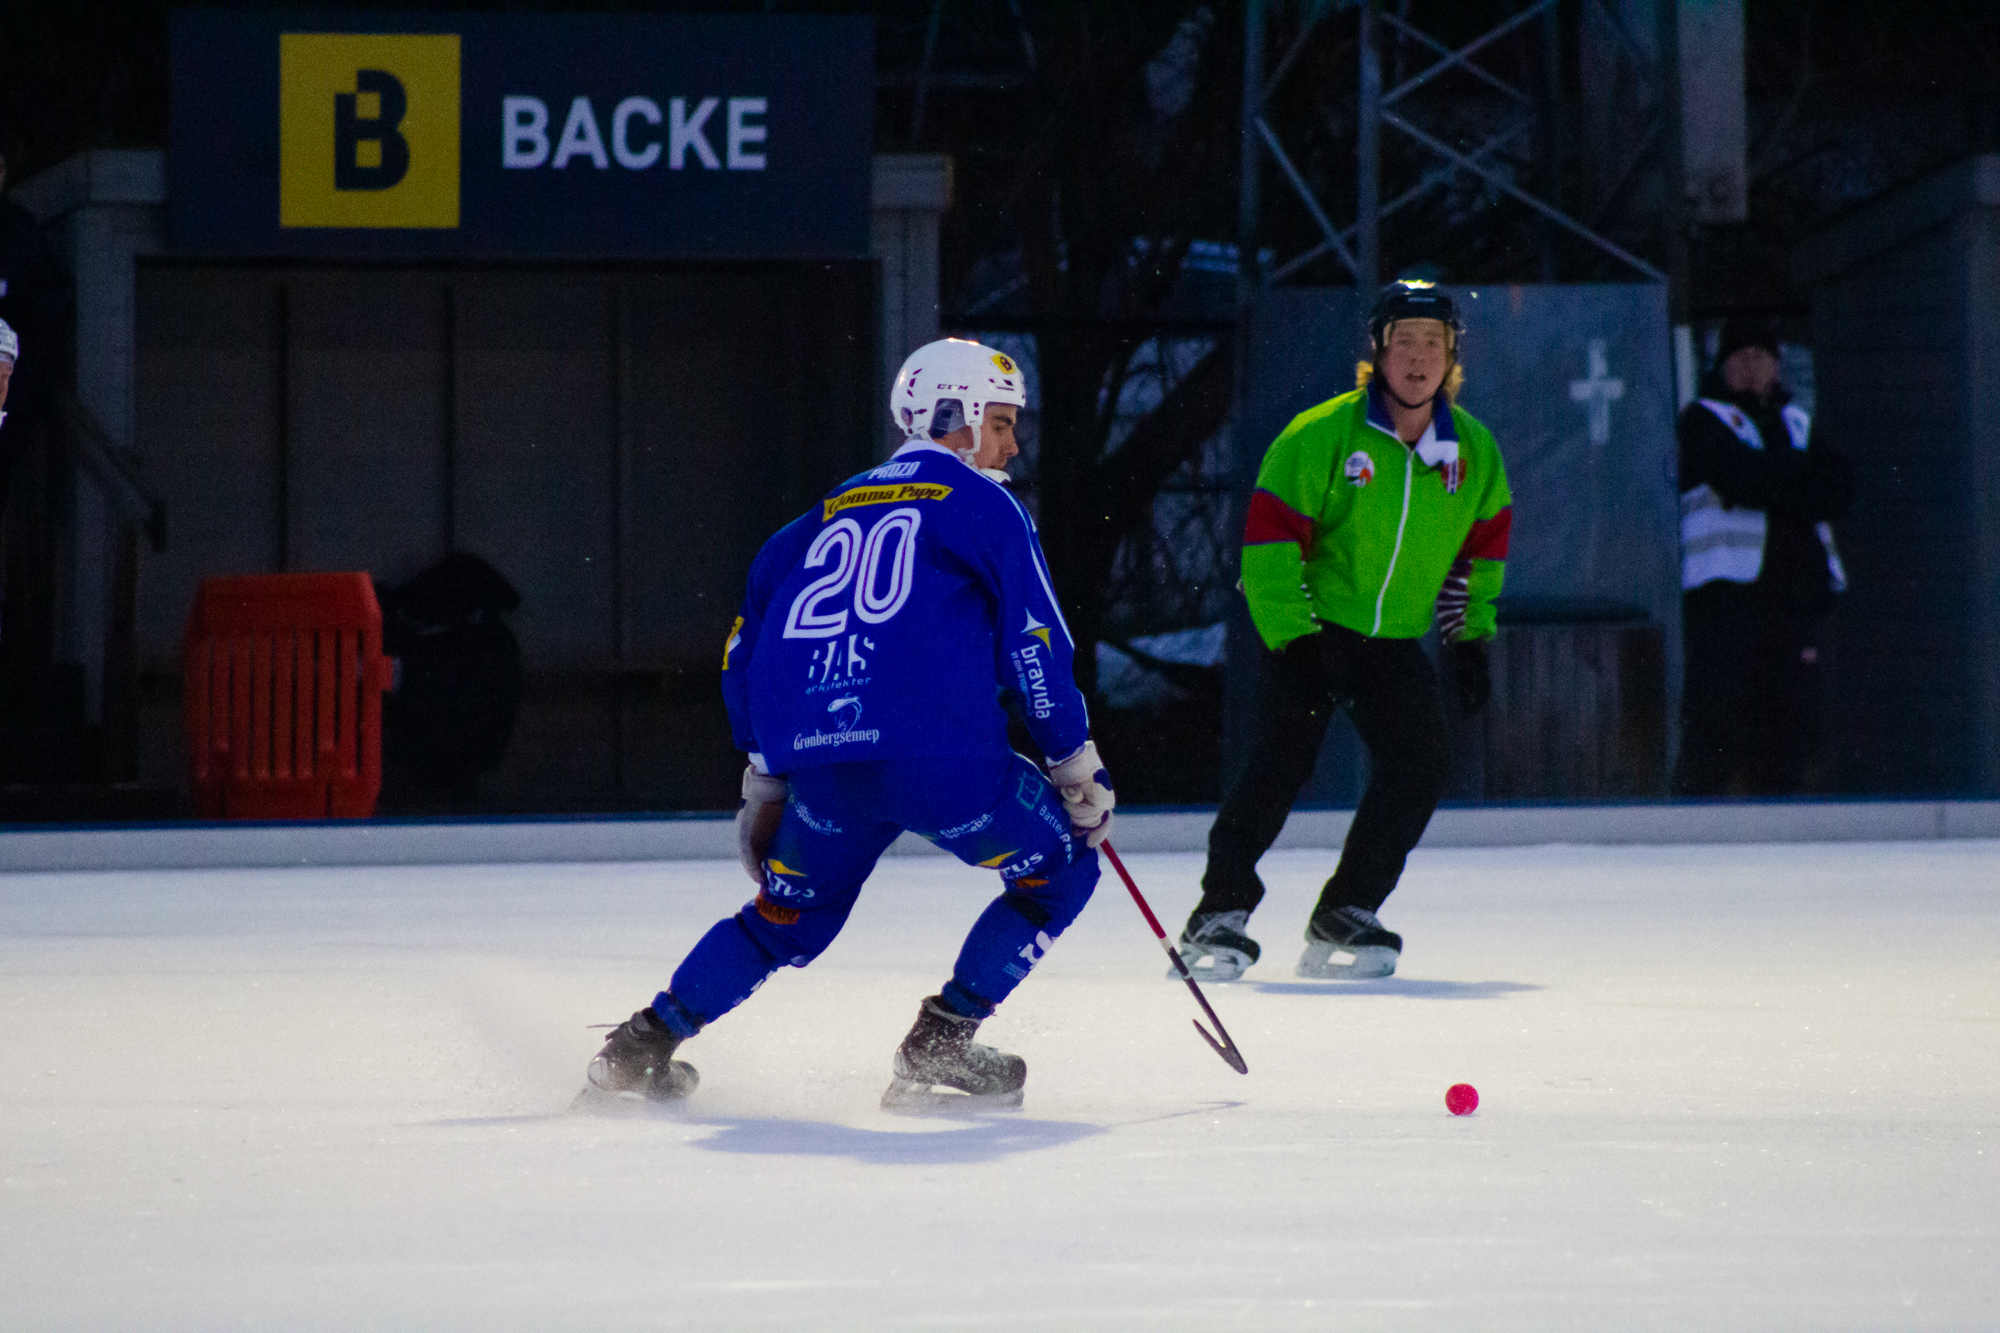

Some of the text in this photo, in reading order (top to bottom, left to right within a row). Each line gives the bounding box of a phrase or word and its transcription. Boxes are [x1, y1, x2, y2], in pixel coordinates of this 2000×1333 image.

[334, 68, 411, 191] B
[502, 94, 768, 171] BACKE
[936, 383, 969, 392] CCM
[828, 485, 943, 515] Glomma Papp
[782, 507, 922, 639] 20
[805, 677, 872, 694] arkitekter
[1020, 643, 1056, 719] bravida
[793, 728, 880, 751] Grønbergsennep
